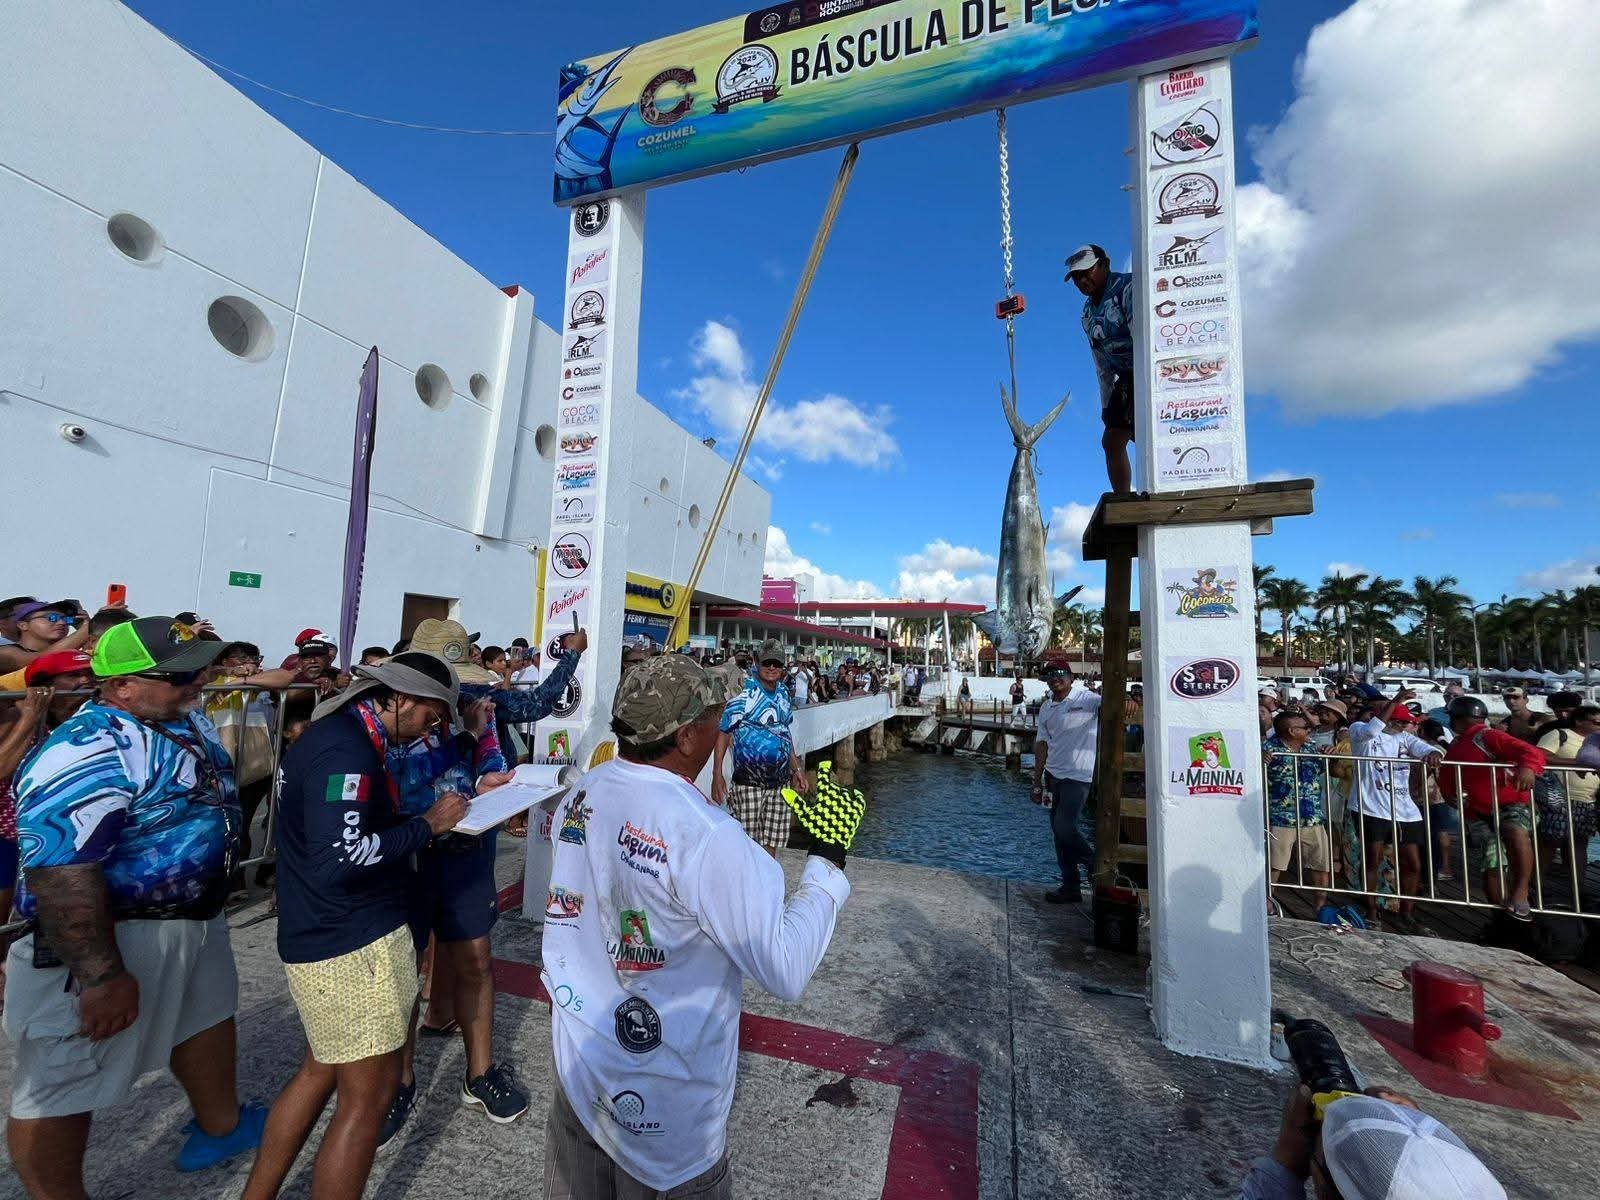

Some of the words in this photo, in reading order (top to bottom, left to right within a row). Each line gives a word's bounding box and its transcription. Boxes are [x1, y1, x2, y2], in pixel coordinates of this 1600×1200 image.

[790, 8, 947, 85] BÁSCULA
[960, 0, 1008, 41] DE
[737, 54, 758, 63] 2025
[637, 124, 697, 147] COZUMEL
[1163, 250, 1197, 267] RLM
[1172, 273, 1224, 288] QUINTANA
[1180, 296, 1228, 308] COZUMEL
[1166, 333, 1218, 346] BEACH
[1167, 397, 1223, 410] Restaurant
[1173, 406, 1229, 422] Laguna
[1181, 594, 1233, 614] Coconuts
[627, 614, 647, 625] FERRY
[1183, 682, 1229, 690] STEREO
